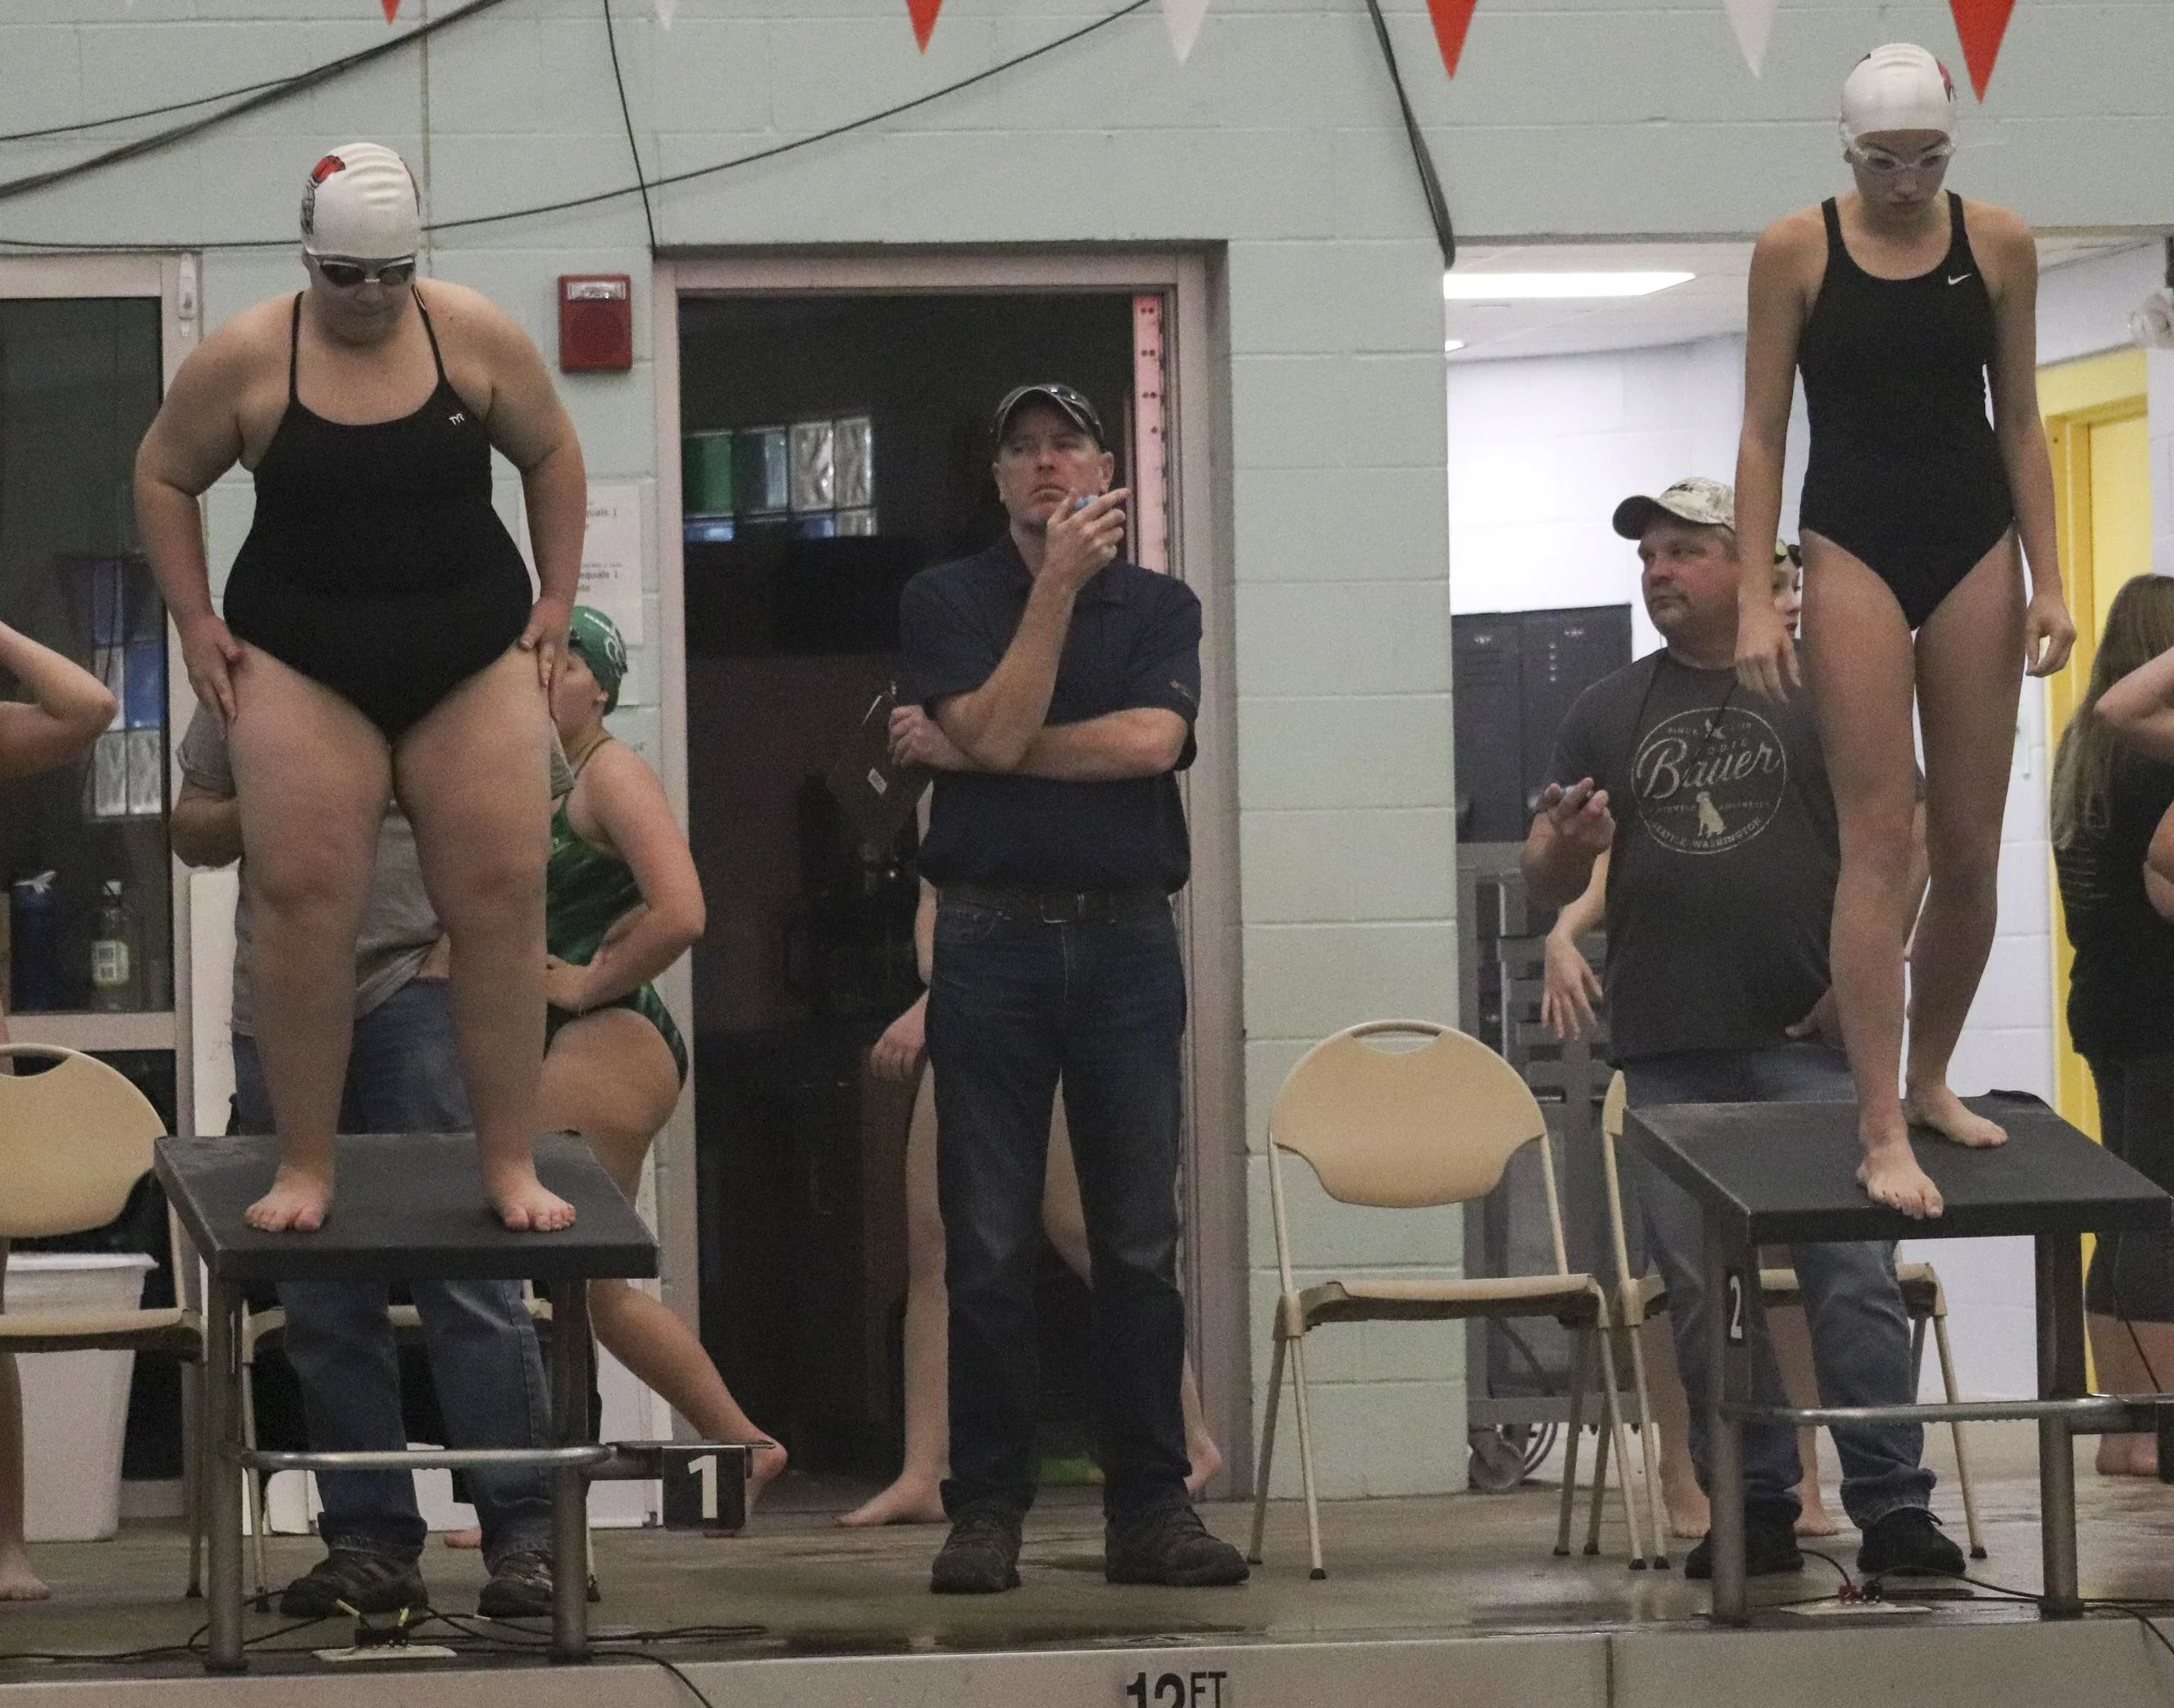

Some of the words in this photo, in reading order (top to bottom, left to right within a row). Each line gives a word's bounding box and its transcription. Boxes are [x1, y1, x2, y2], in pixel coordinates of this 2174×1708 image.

[449, 413, 465, 425] TYR
[1636, 737, 1781, 799] Bauer
[1730, 1275, 1743, 1339] 2
[687, 1454, 718, 1518] 1
